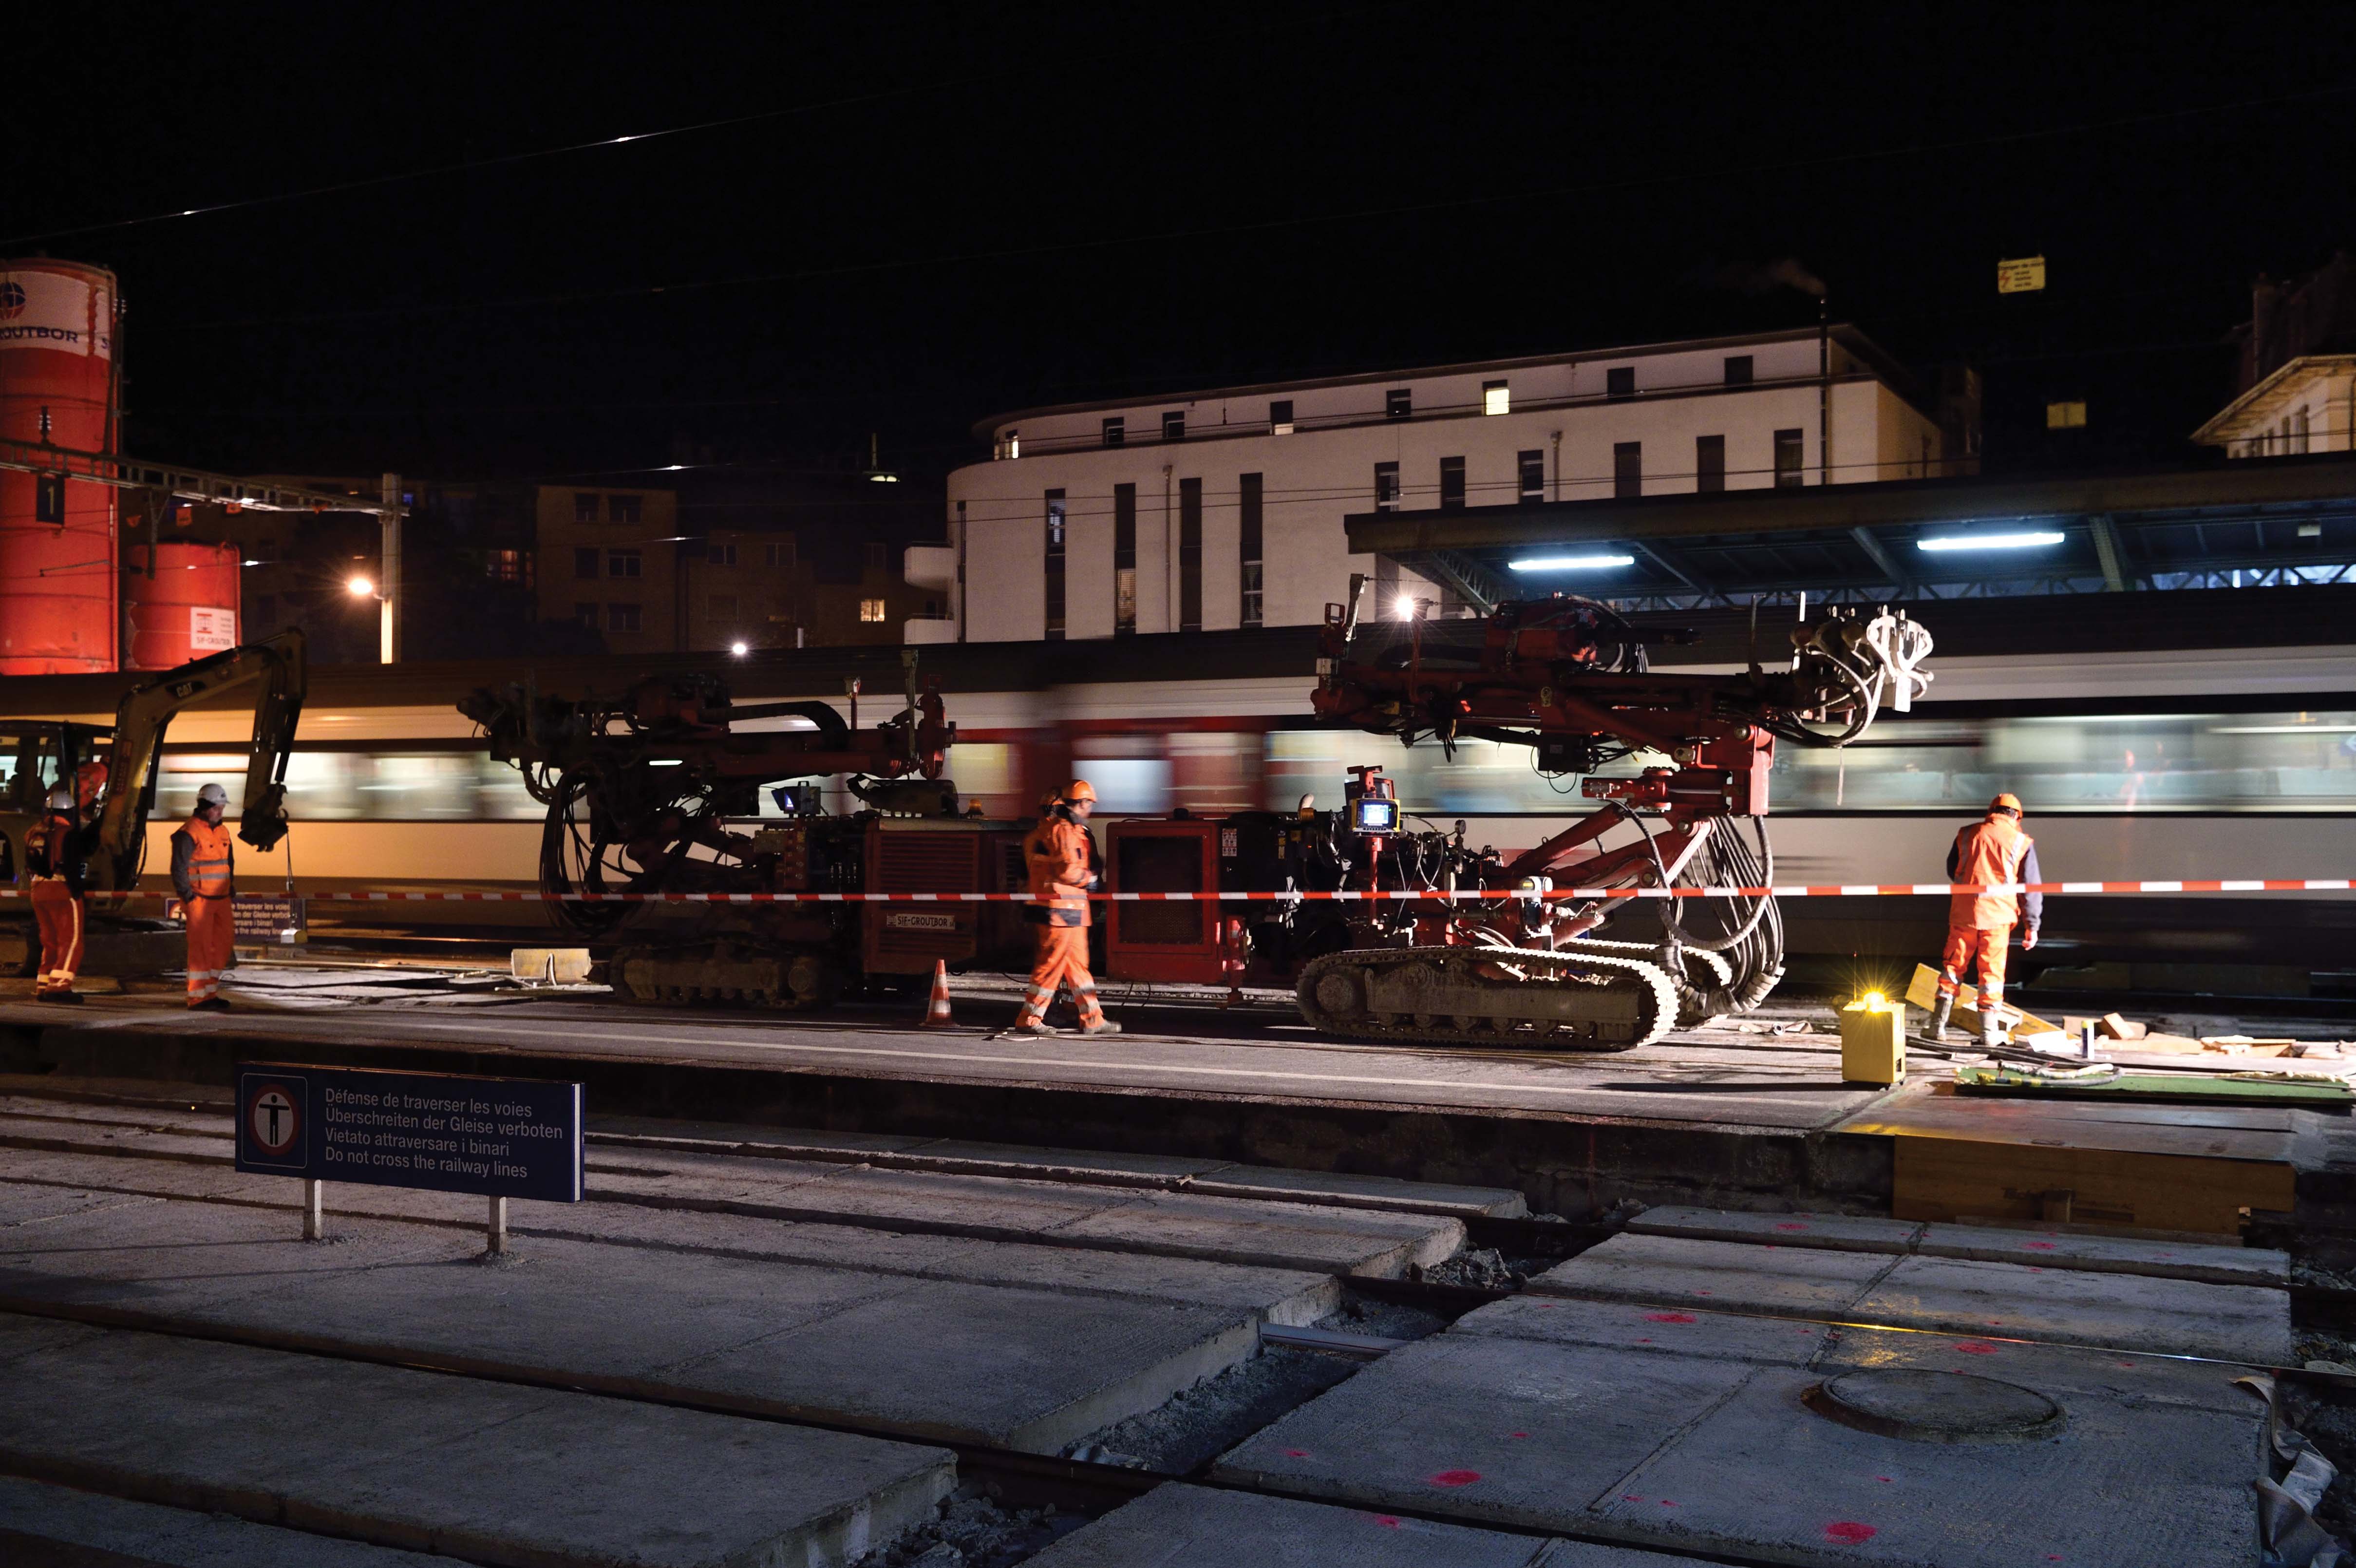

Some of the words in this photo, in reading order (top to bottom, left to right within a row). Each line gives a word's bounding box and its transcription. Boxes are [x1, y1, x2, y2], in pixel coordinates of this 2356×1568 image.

[176, 682, 193, 698] CAT
[898, 916, 947, 927] SIF-GROUTBOR
[325, 1088, 378, 1106] Défense
[383, 1092, 399, 1108] de
[403, 1095, 466, 1113] traverser
[470, 1098, 490, 1115] les
[494, 1101, 532, 1117] voies
[326, 1103, 418, 1128] Überschreiten
[423, 1115, 446, 1130] der
[450, 1116, 493, 1134] Gleise
[498, 1121, 563, 1139] verboten
[325, 1127, 371, 1145] Vietato
[375, 1133, 457, 1152] attraversare
[462, 1138, 465, 1153] i
[470, 1138, 509, 1156] binari
[325, 1146, 343, 1162] Do
[347, 1151, 369, 1164] not
[373, 1153, 410, 1168] cross
[414, 1154, 435, 1170] the
[440, 1157, 490, 1178] railway
[494, 1160, 528, 1178] lines
